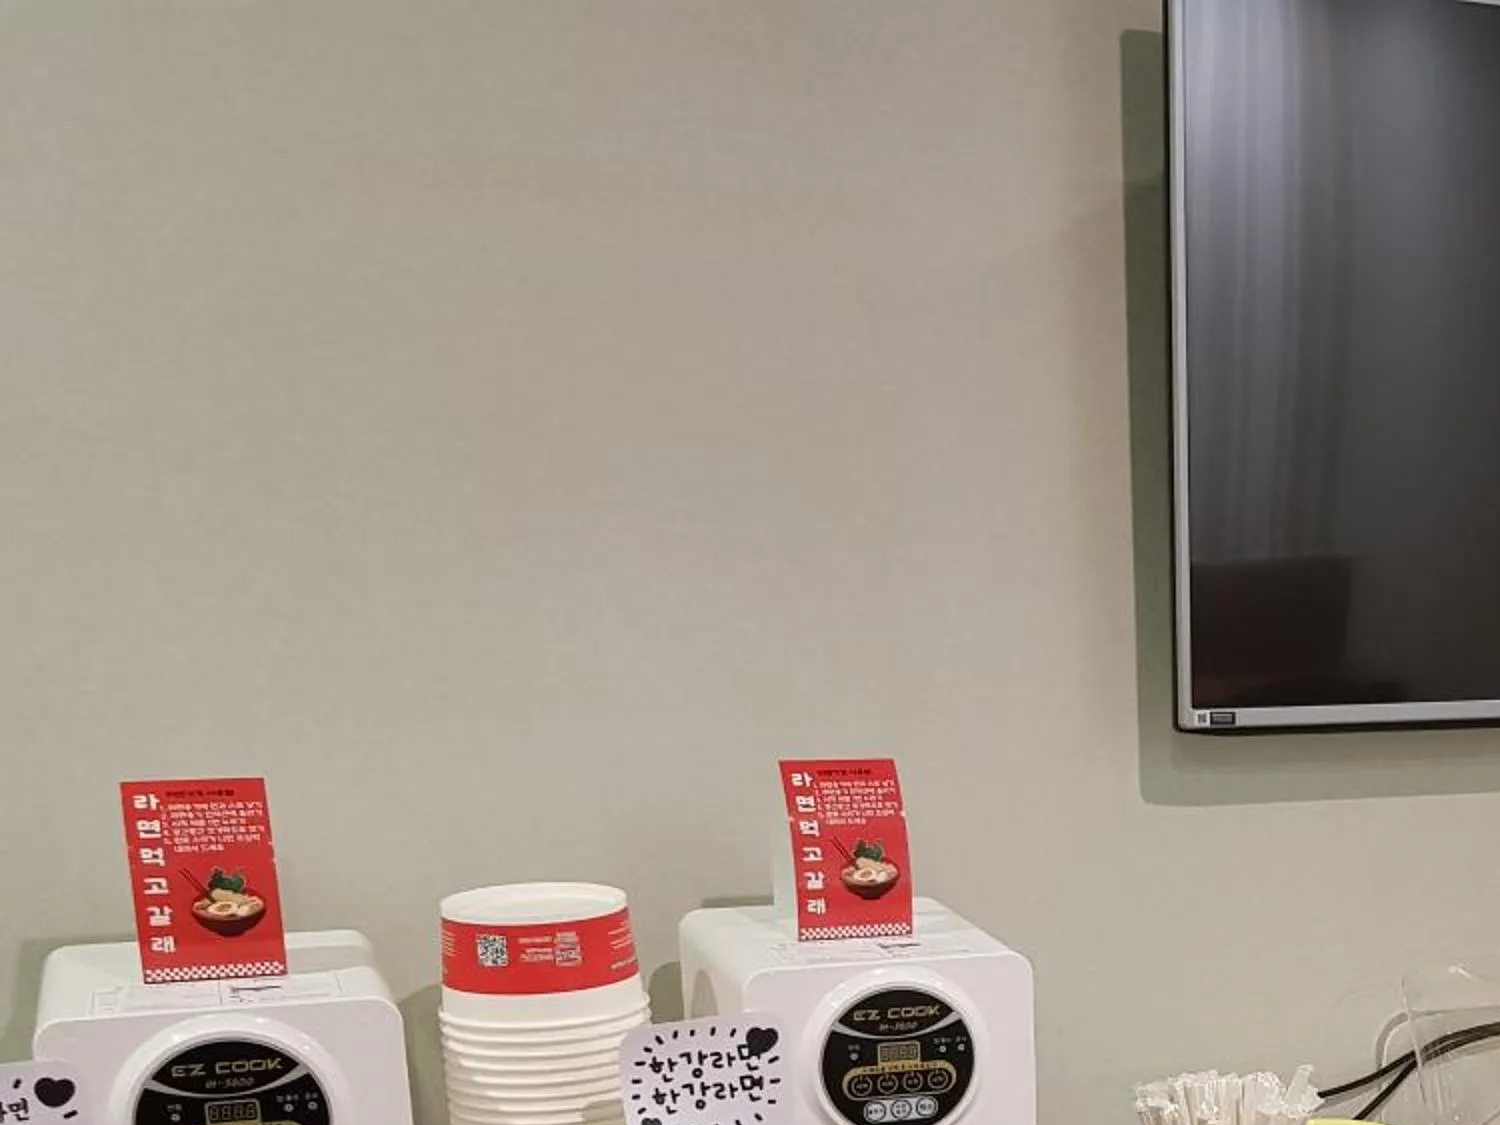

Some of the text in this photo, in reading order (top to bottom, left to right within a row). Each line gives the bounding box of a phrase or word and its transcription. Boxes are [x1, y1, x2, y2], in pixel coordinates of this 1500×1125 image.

[853, 1004, 941, 1021] EZ COOK
[171, 1057, 284, 1078] EZ COOK
[652, 1075, 763, 1115] 한강라면
